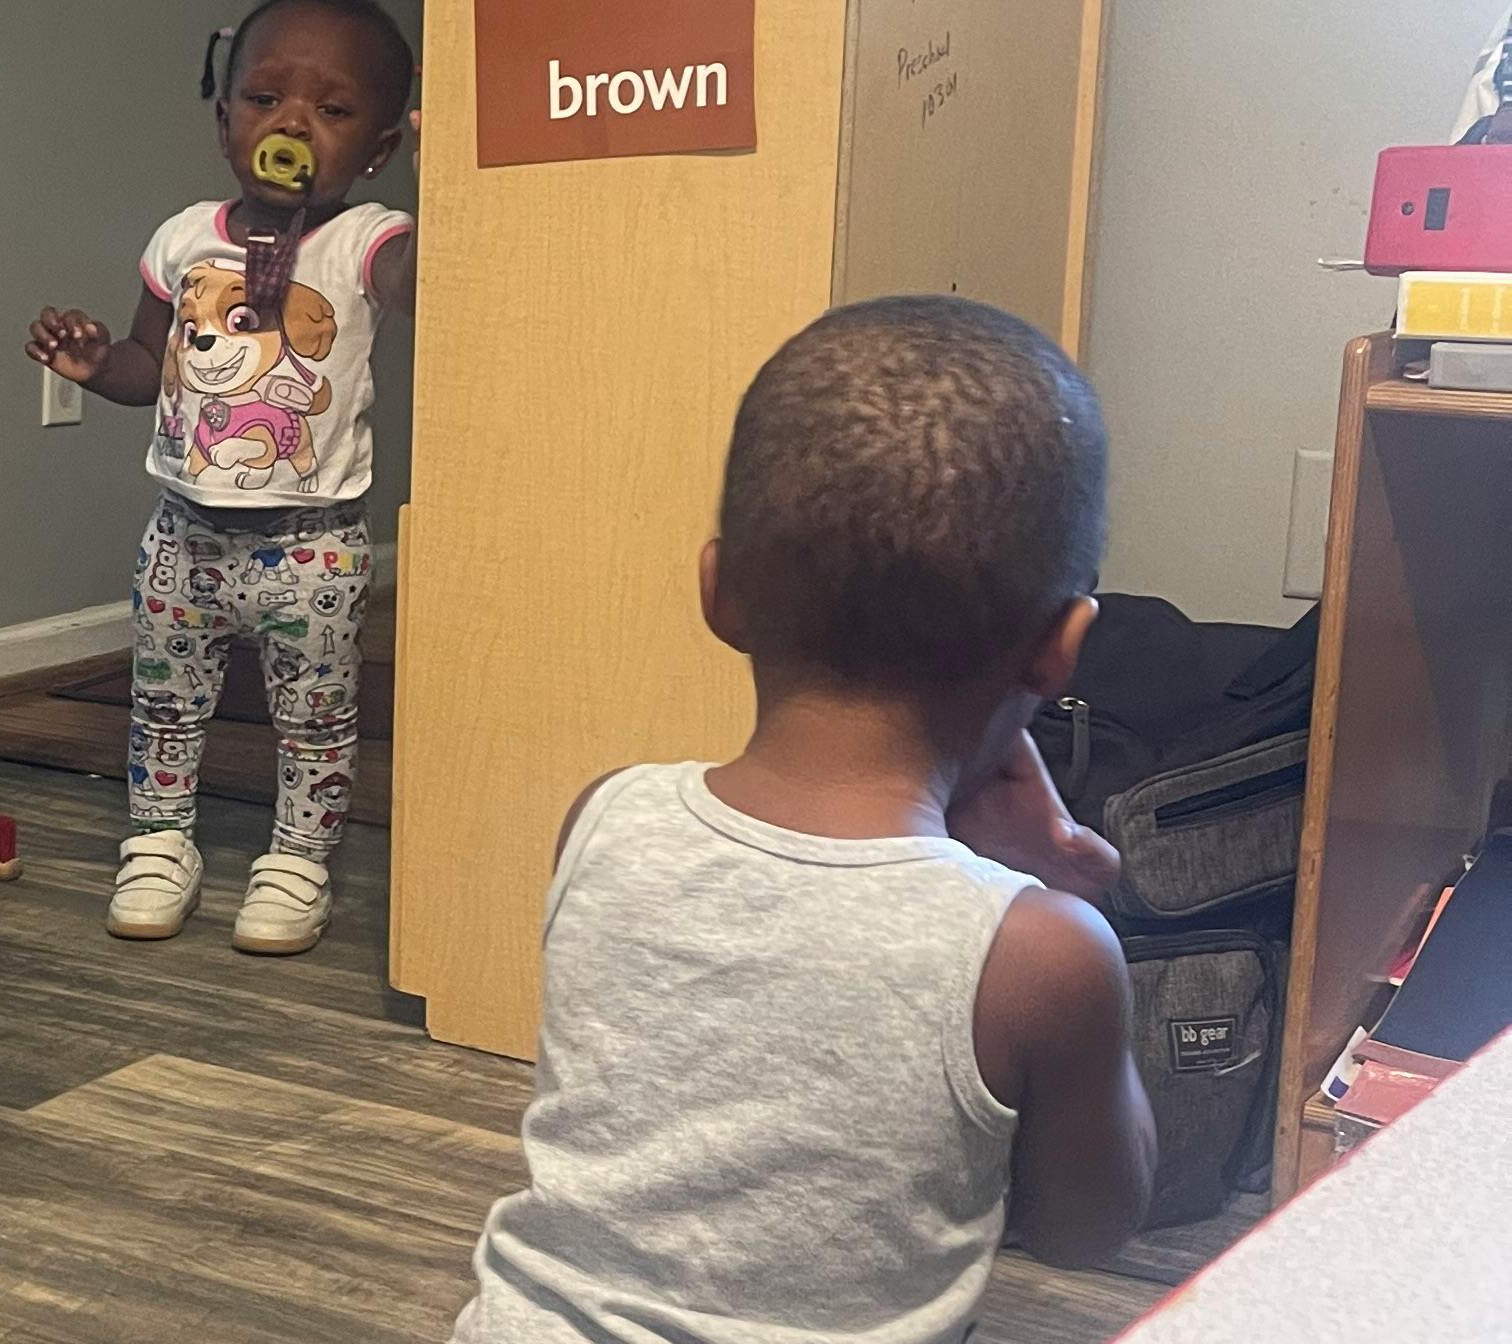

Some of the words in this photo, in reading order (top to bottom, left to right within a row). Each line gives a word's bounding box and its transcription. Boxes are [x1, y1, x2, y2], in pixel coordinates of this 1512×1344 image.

[547, 59, 729, 120] brown
[1180, 1026, 1197, 1042] bb
[1199, 1027, 1228, 1046] gear
